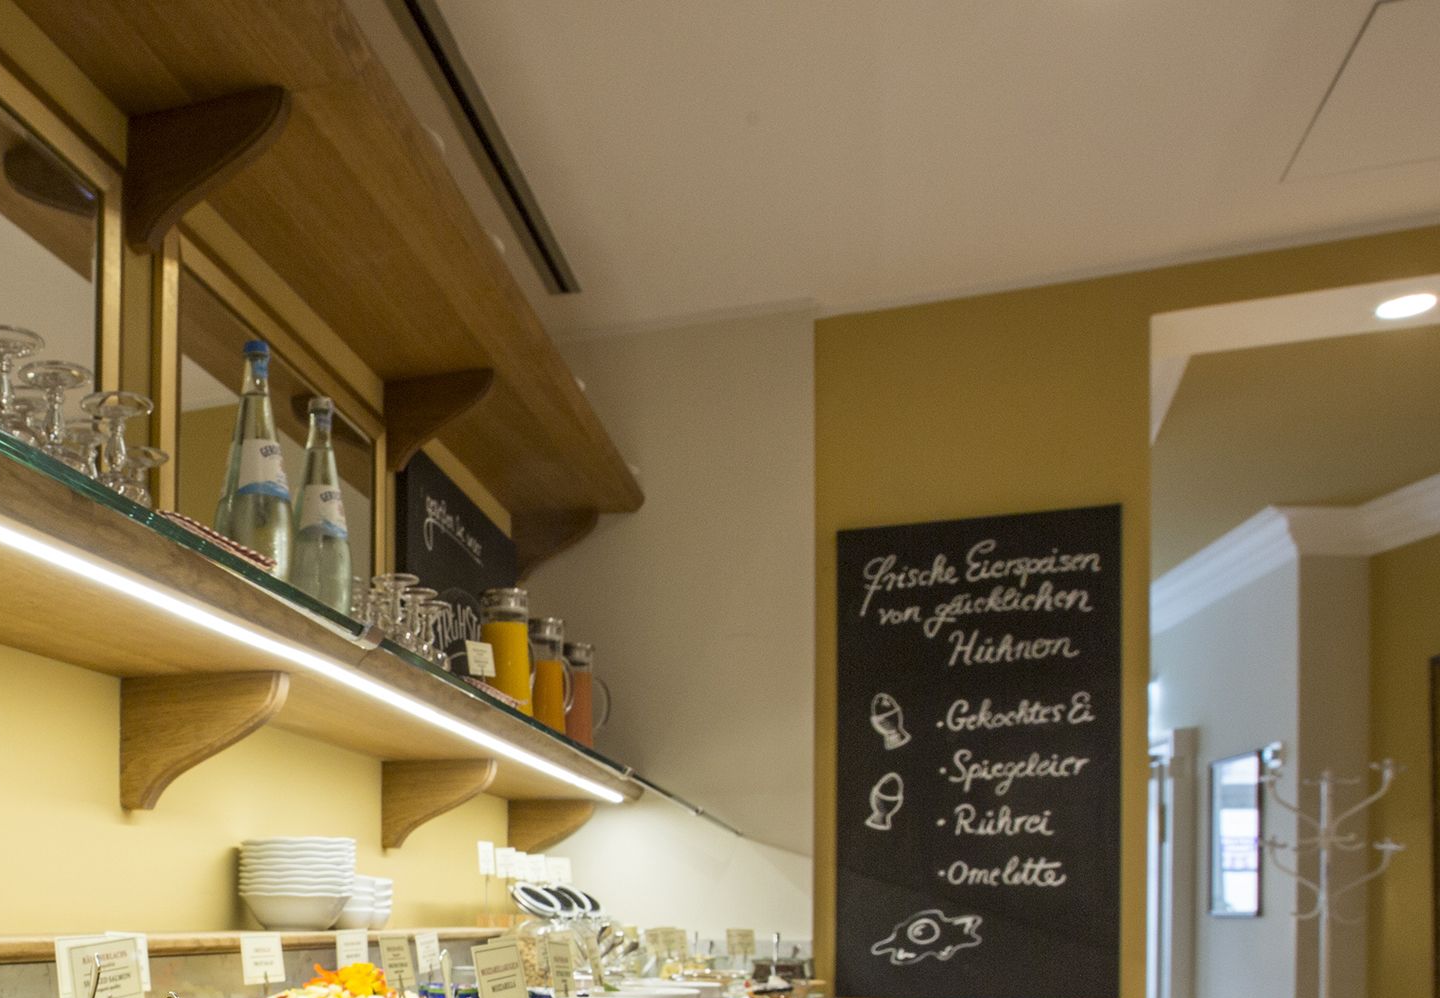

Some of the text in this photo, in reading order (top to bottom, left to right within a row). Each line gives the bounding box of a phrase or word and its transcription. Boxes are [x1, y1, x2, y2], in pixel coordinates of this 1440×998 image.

[859, 538, 1101, 617] Frische Eierspeisen
[878, 580, 1094, 639] von glücklichen
[948, 629, 1080, 667] Hühnern
[946, 691, 1096, 732] Gekochtes Ei
[948, 749, 1090, 796] Spiegeleier
[954, 803, 1055, 836] Rührei
[947, 856, 1067, 887] Omelette
